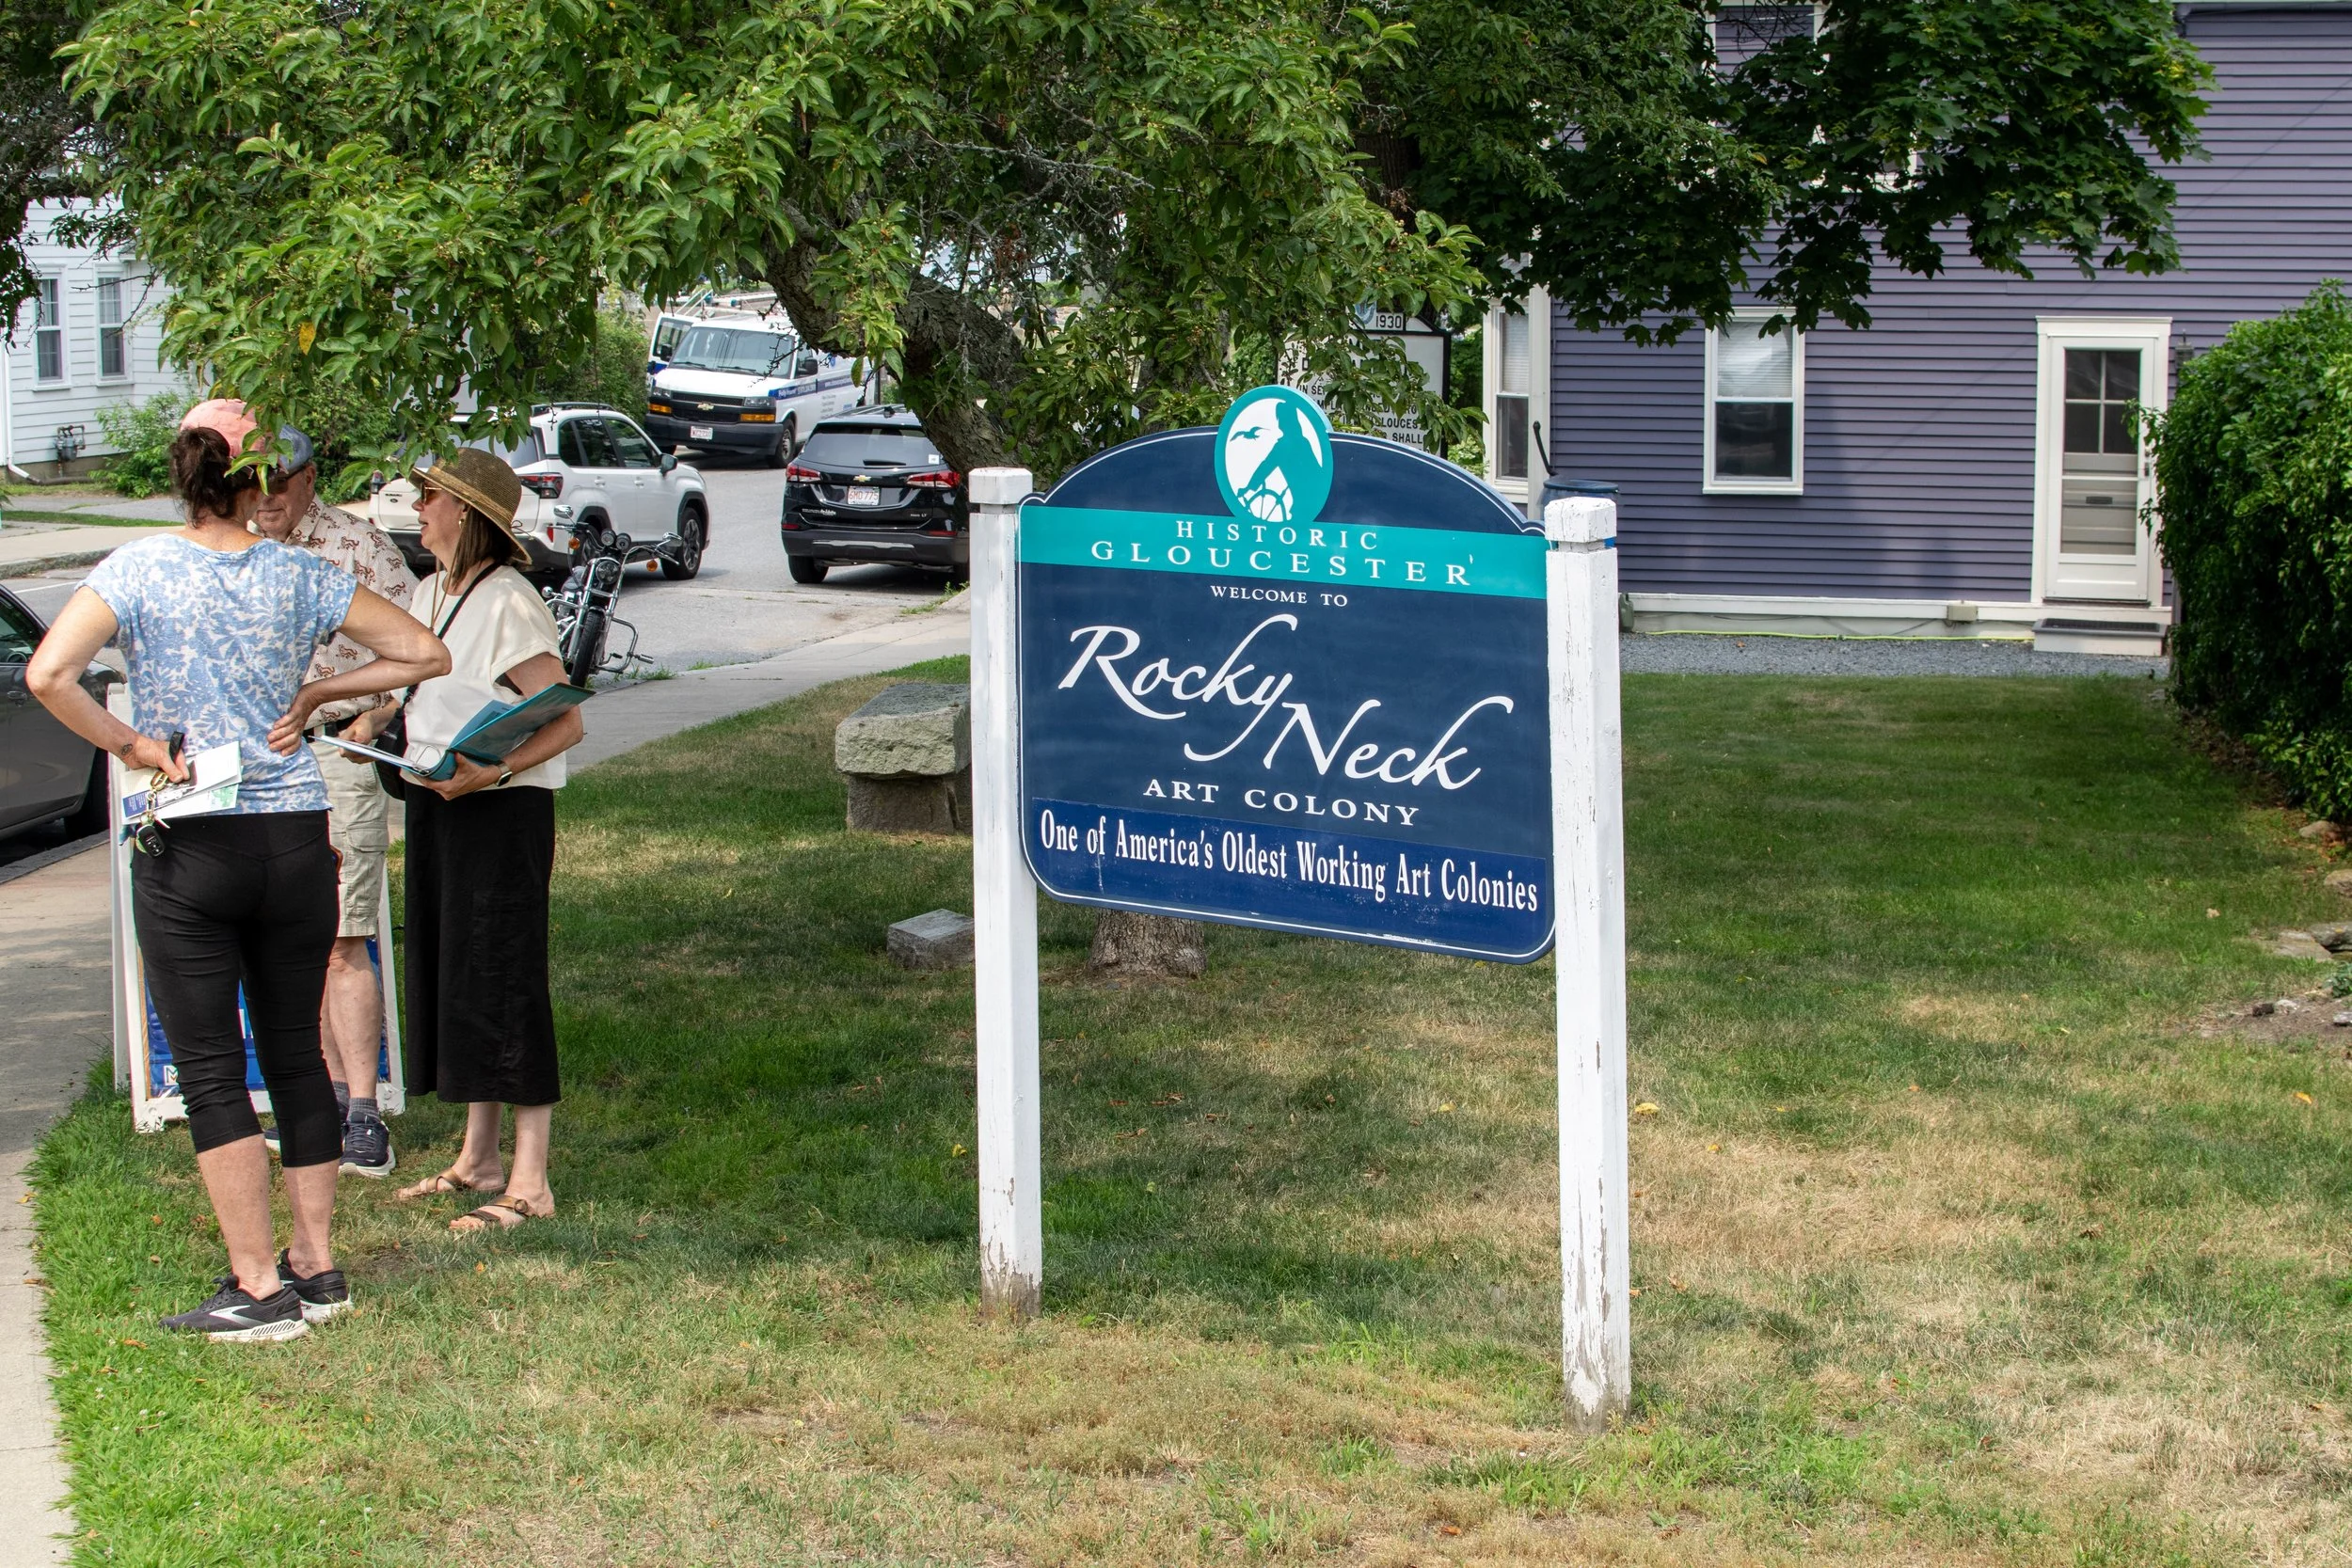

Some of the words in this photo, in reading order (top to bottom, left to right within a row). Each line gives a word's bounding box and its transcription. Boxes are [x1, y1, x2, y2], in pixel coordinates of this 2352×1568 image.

[1375, 314, 1402, 328] 1930
[1176, 520, 1378, 551] HISTORIC
[1091, 541, 1470, 586] GLOUCESTER
[1210, 585, 1308, 605] WELCOME
[1320, 594, 1348, 608] TO
[1057, 613, 1298, 762] Rocky
[1263, 695, 1515, 791] Neck
[1142, 778, 1220, 804] ART
[1244, 789, 1421, 827] COLONY
[1041, 809, 1078, 852] One
[1087, 816, 1107, 856] of
[1115, 818, 1214, 870] America's
[1222, 831, 1288, 880] Oldest
[1295, 840, 1386, 903] Working
[1395, 853, 1432, 898] Art
[1440, 858, 1538, 912] Colonies
